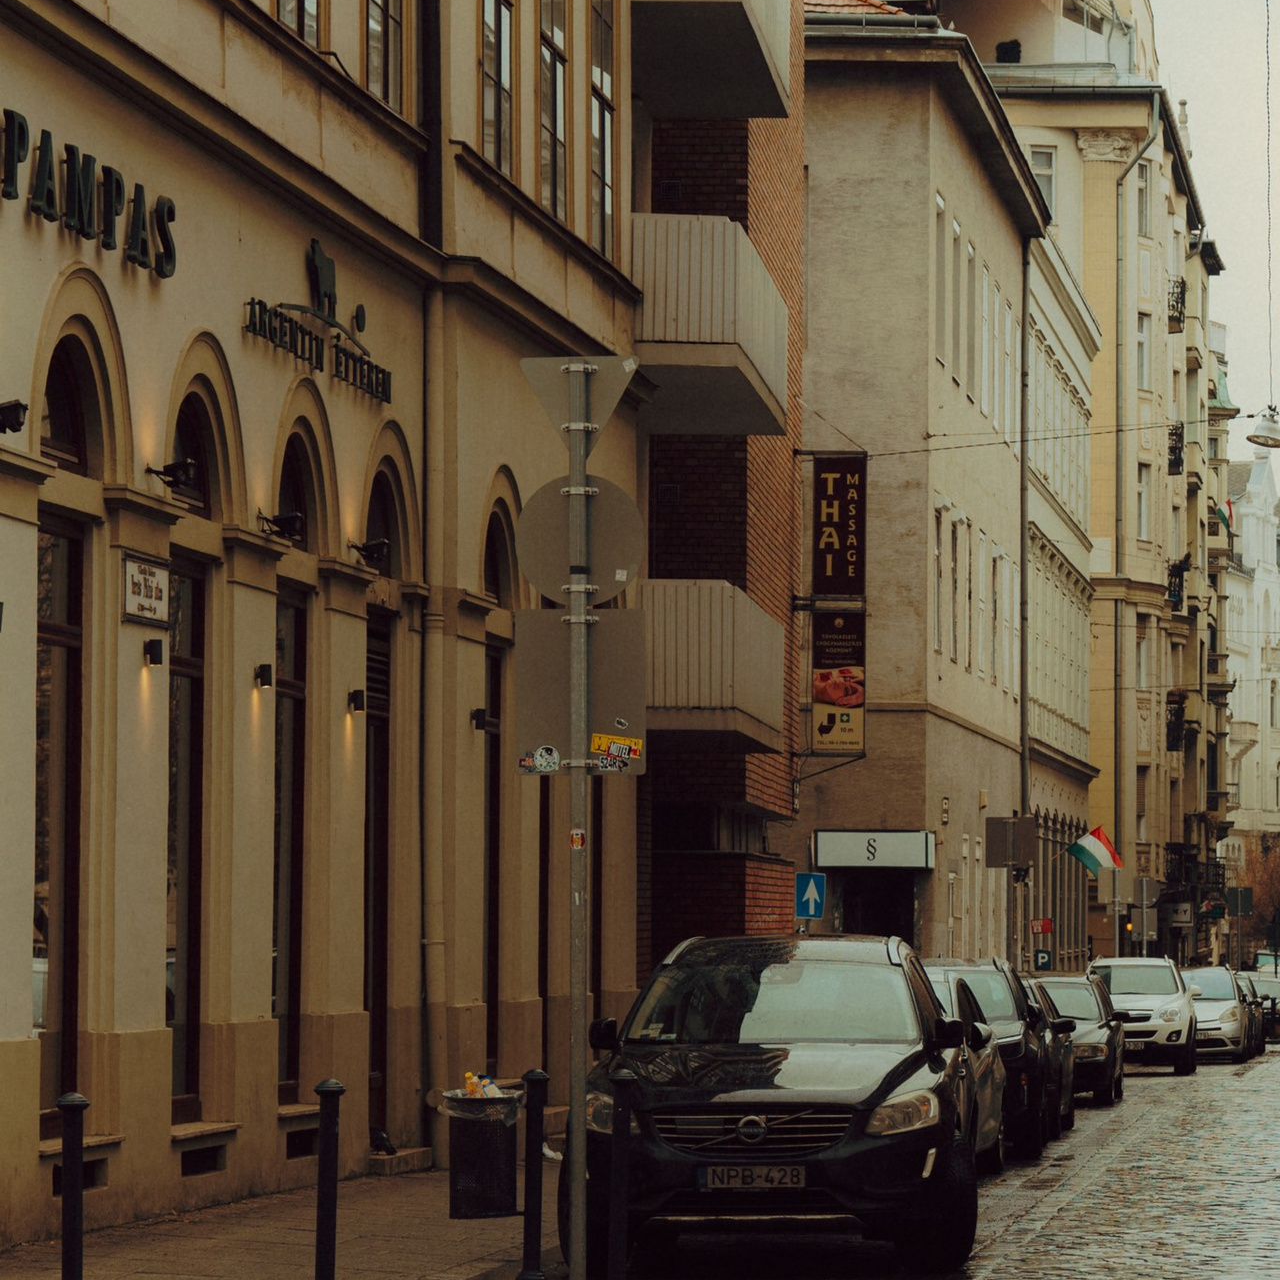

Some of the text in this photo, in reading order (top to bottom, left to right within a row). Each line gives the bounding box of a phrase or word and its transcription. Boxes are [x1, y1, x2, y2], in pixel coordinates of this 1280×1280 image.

[1, 108, 177, 279] PAMPAS
[246, 297, 392, 404] ARGENTIN ÉTTEREM
[819, 472, 841, 576] THAI
[846, 473, 859, 577] MASSAGE
[866, 838, 877, 861] §
[1037, 952, 1049, 966] P
[711, 1167, 801, 1185] NPB-428
